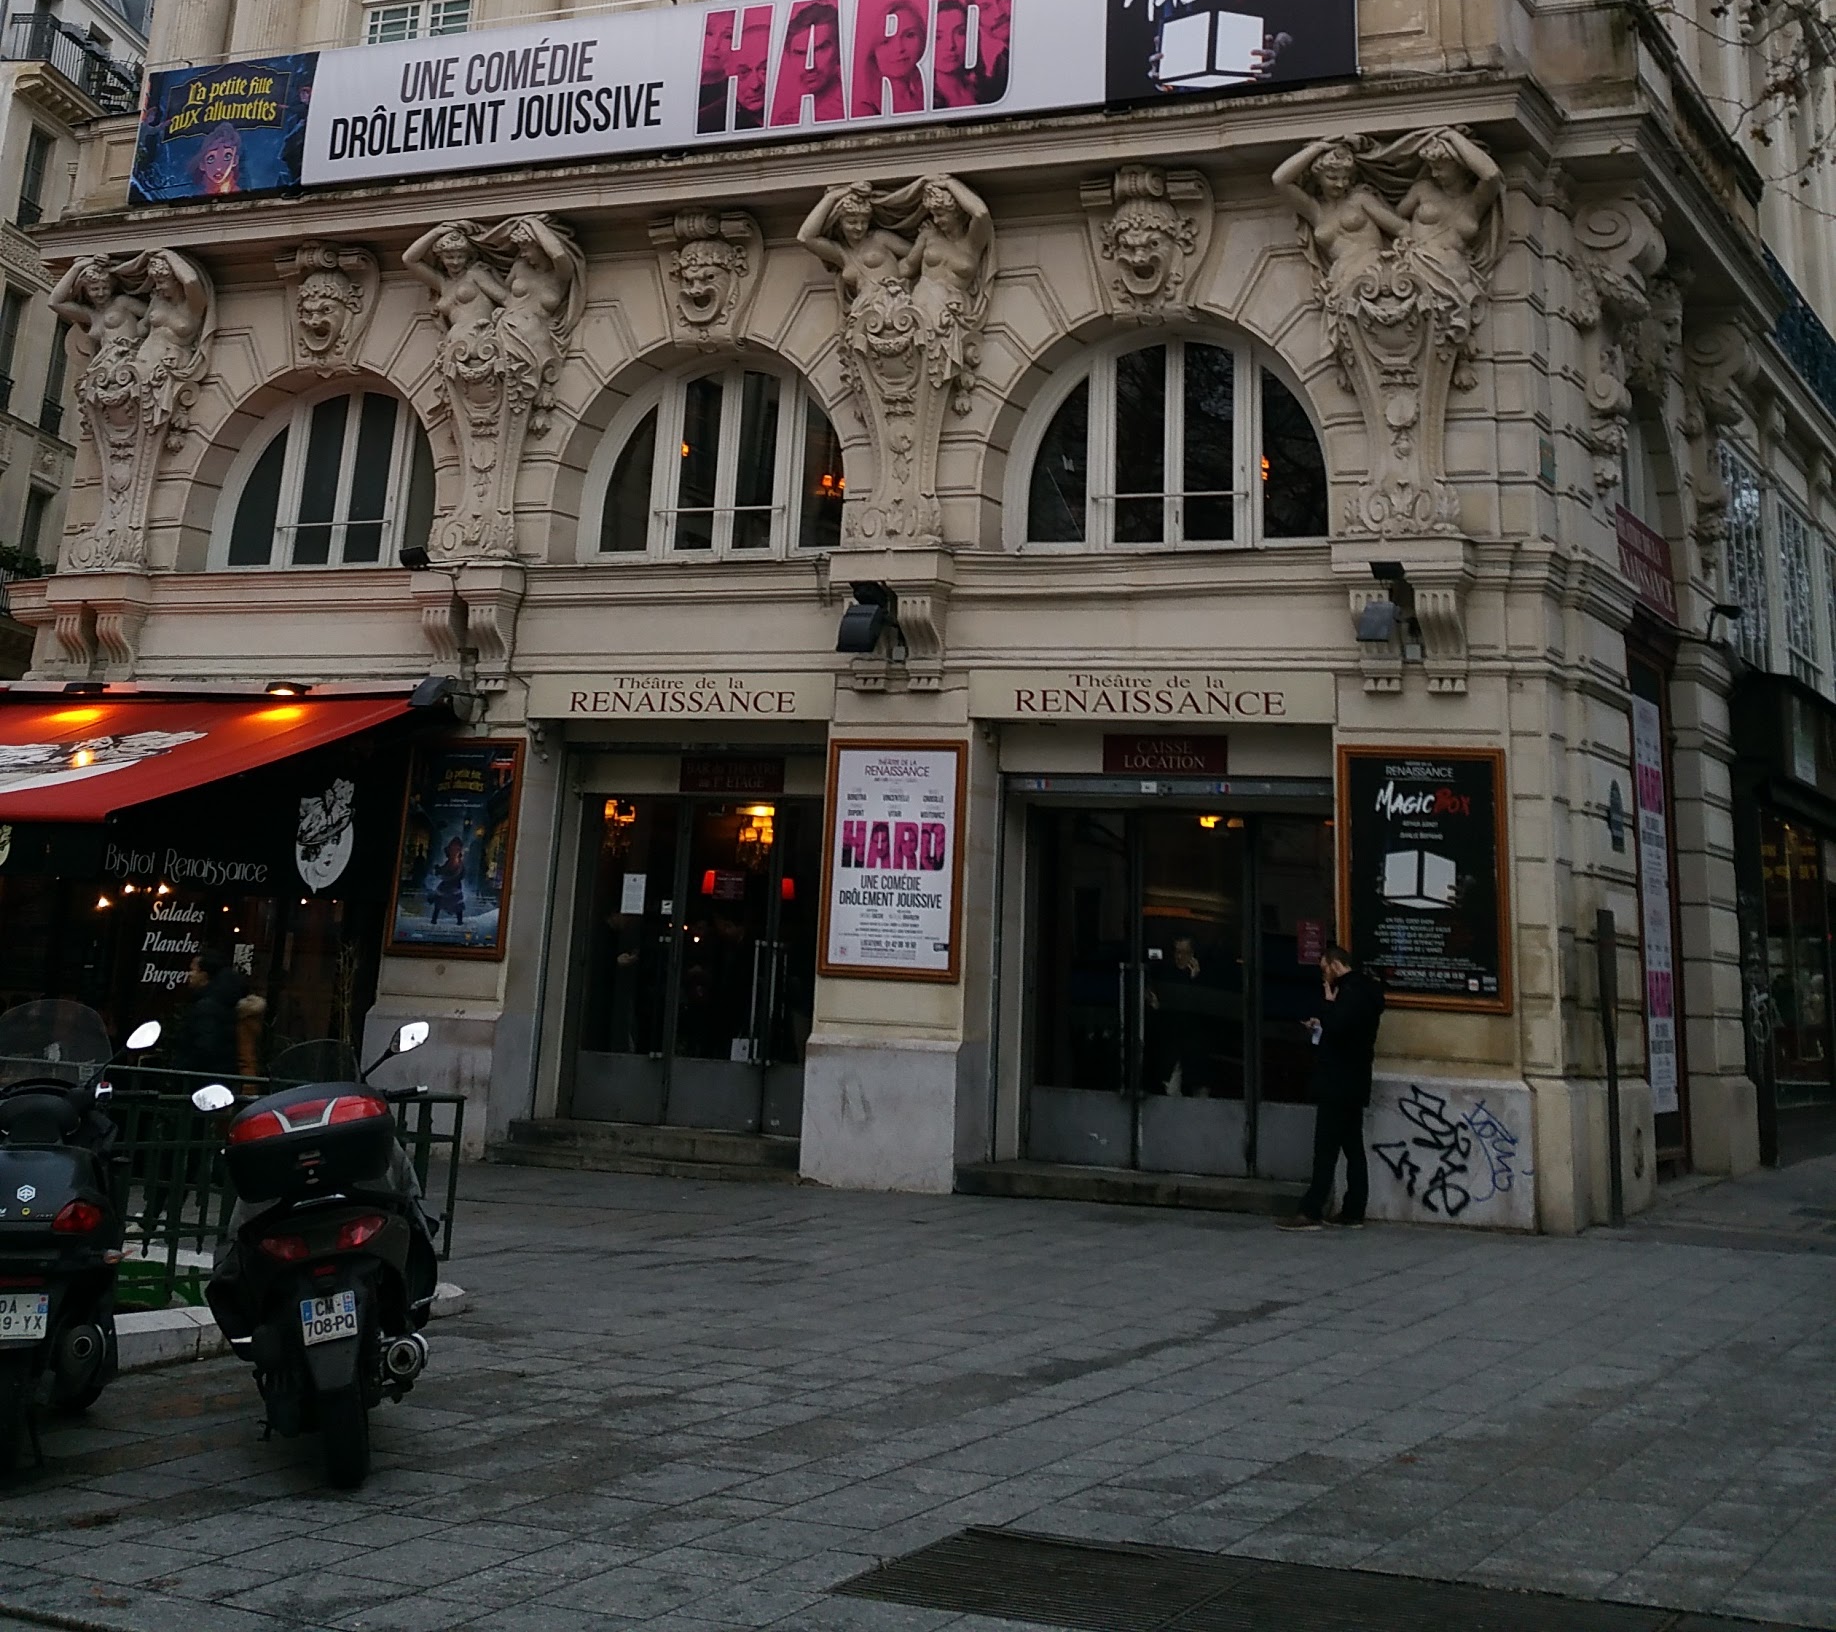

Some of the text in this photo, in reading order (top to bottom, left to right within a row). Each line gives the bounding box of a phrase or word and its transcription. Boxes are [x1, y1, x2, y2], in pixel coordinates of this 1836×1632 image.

[399, 38, 598, 104] UNE COMÉDIE
[184, 74, 274, 108] La petite fille
[168, 97, 277, 135] aux allumettes
[328, 81, 664, 161] DRÔLEMENT JOUISSIVE
[613, 676, 744, 690] Théâtre de la
[1069, 673, 1224, 689] Théâtre de la
[569, 690, 796, 714] RENAISSANCE
[1014, 689, 1286, 716] RENAISSANCE
[1137, 741, 1193, 753] CAISSE
[865, 766, 930, 777] RENAISSANCE
[1124, 755, 1205, 769] LOCATION
[1385, 766, 1454, 778] RENAISSANCE
[841, 820, 945, 871] HARD
[105, 843, 268, 886] Bistrot Renaissance
[861, 873, 921, 891] UNE COMÉDIE
[839, 888, 942, 909] DRÔLEMENT JOUISSIVE
[150, 901, 205, 923] Salades
[141, 931, 202, 954] Planche
[140, 963, 194, 990] Burger
[0, 1315, 43, 1331] 9-YX
[305, 1314, 355, 1337] 708-PQ
